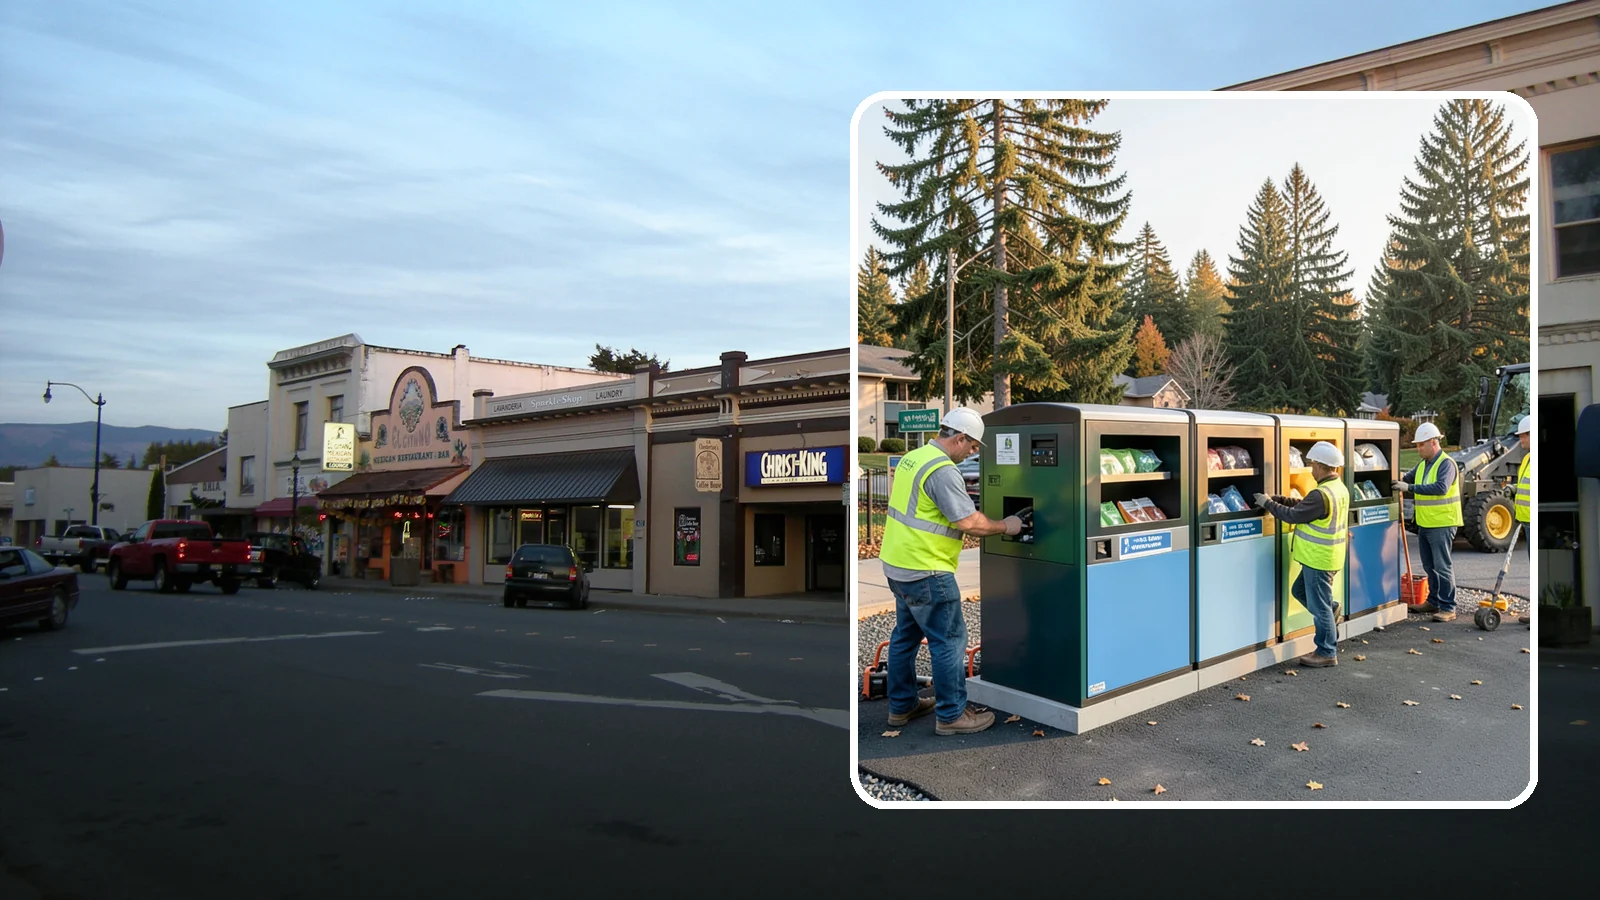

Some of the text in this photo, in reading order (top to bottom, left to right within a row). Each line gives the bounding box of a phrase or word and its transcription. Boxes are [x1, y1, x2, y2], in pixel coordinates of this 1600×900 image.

[595, 388, 623, 400] LAUNDRY
[494, 402, 522, 413] LAVANDERIA
[531, 394, 582, 409] Sparkle Shop
[374, 455, 396, 464] MEXICAN
[398, 451, 433, 462] RESTAURANT
[438, 451, 450, 459] BAR
